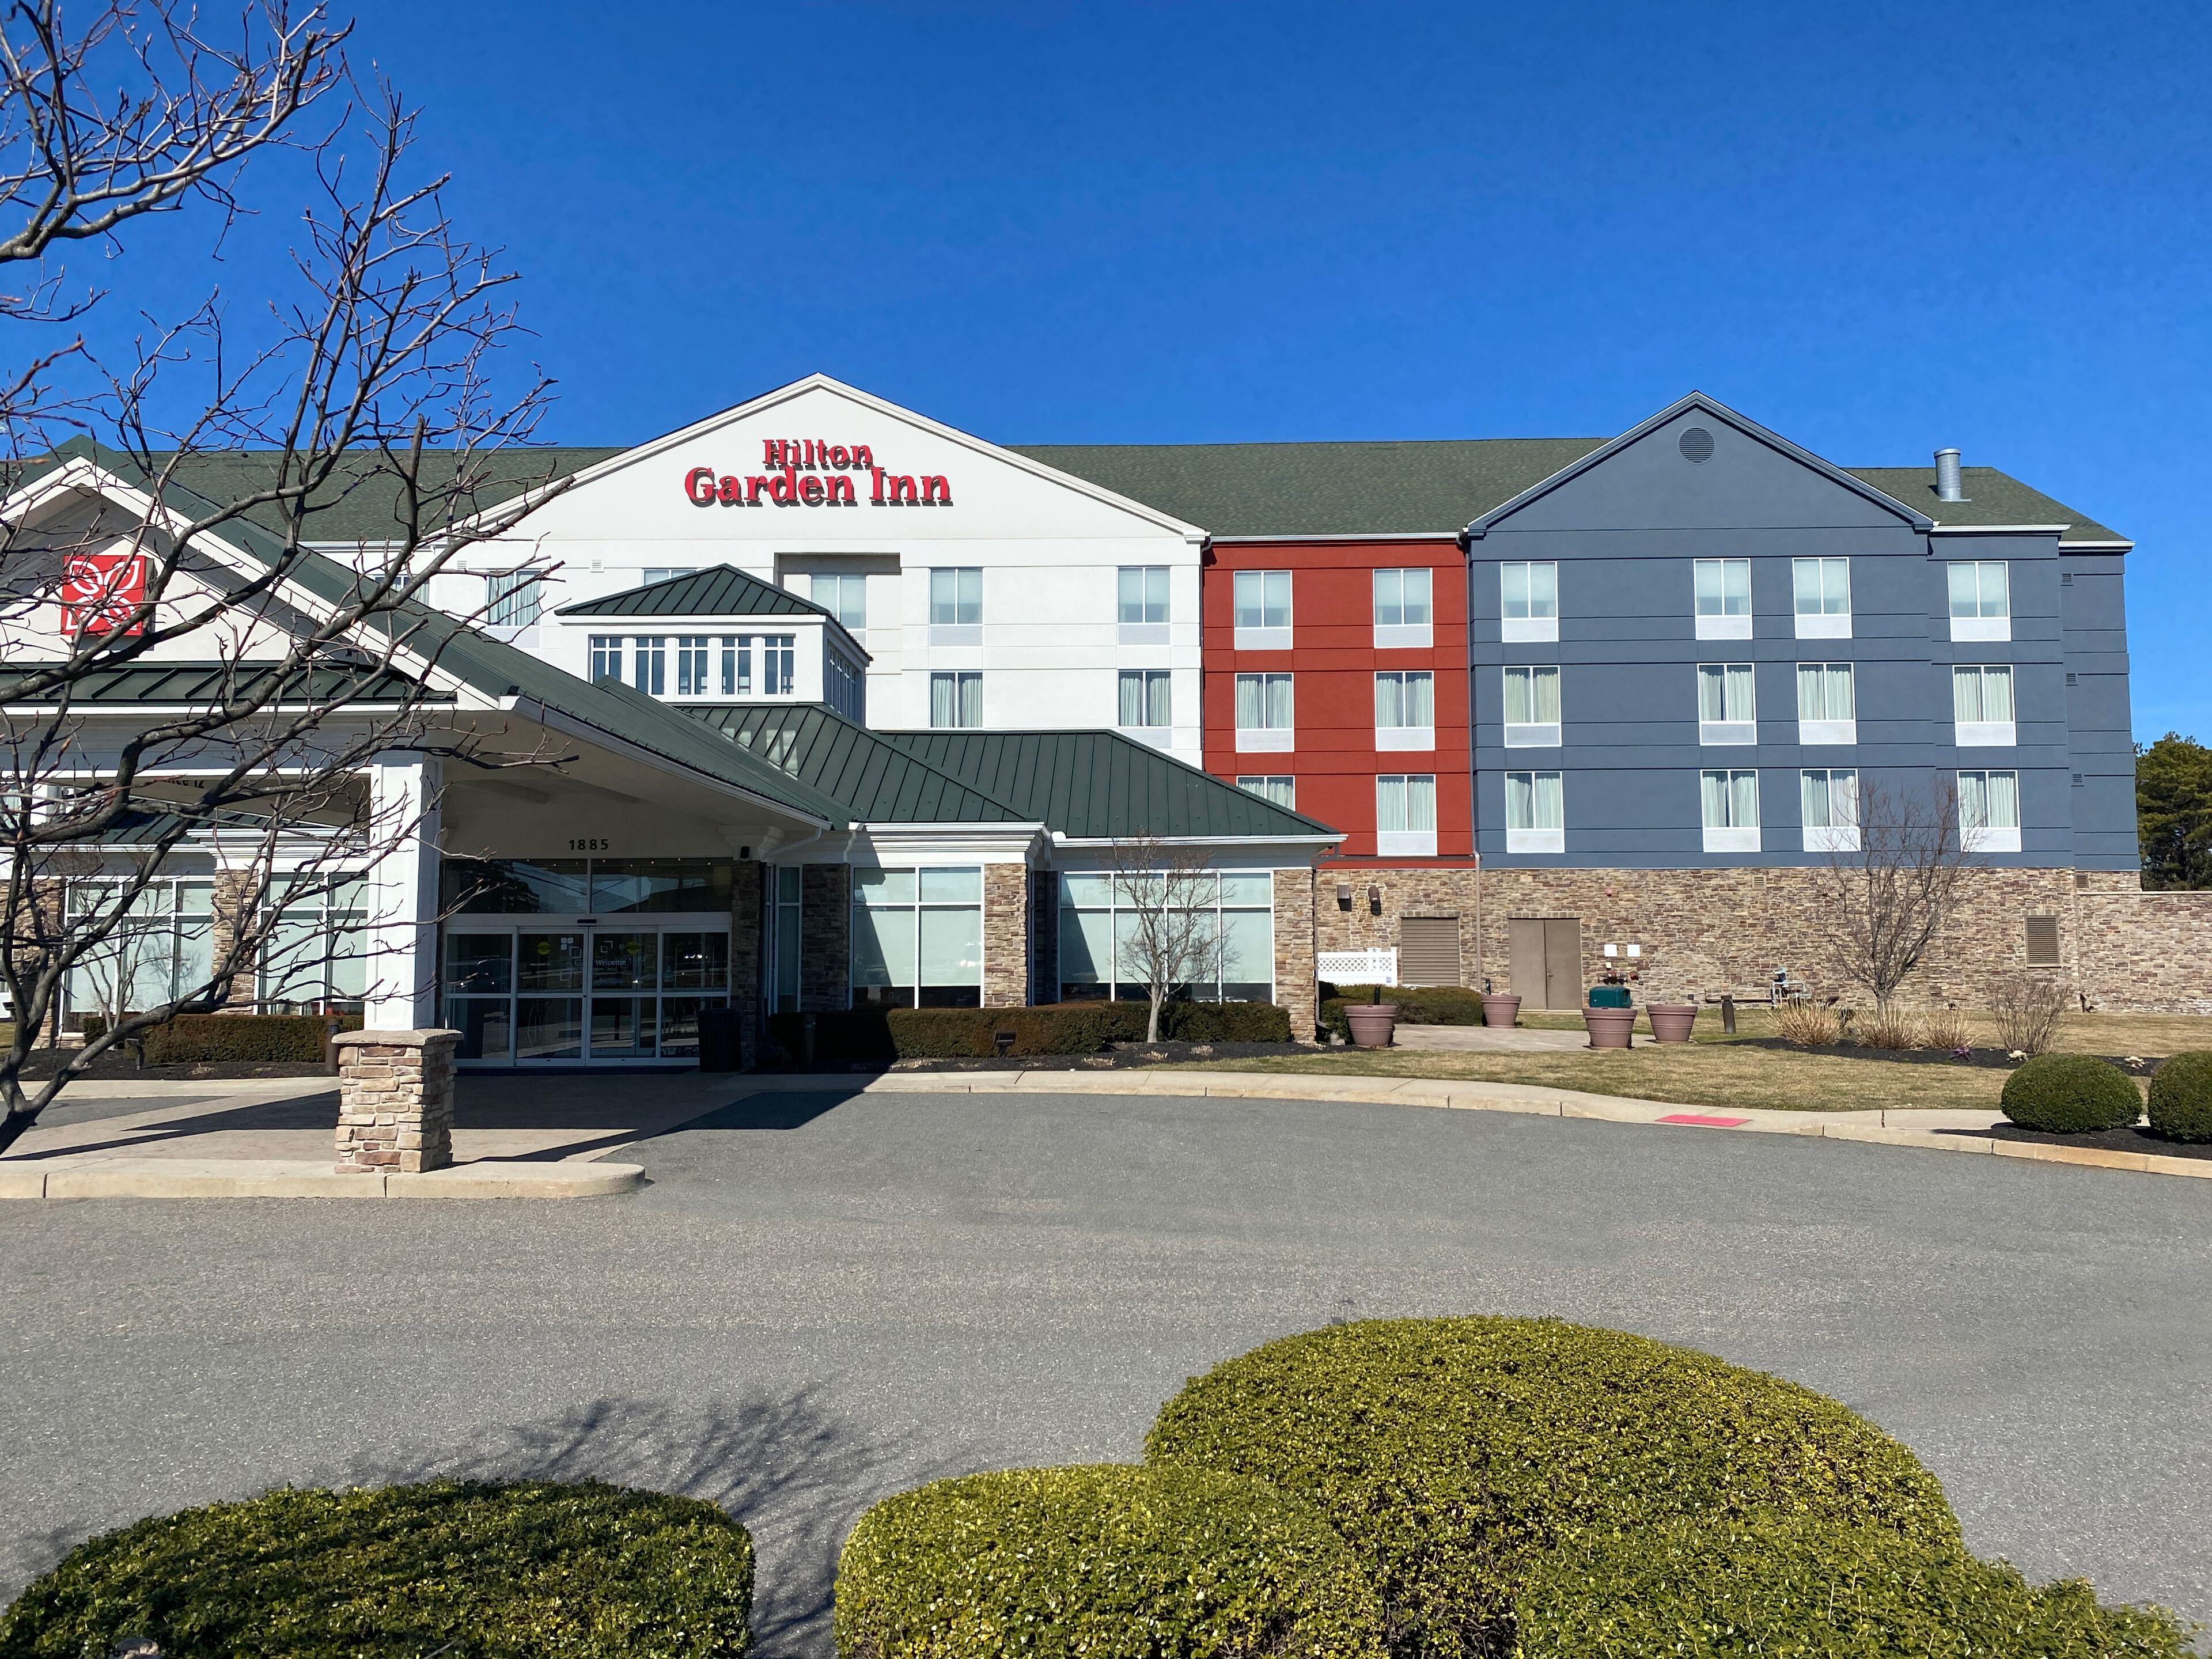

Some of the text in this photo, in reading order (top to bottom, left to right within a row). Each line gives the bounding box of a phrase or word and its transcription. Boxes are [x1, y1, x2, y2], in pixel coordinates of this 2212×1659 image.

[762, 439, 873, 465] Hilton
[684, 464, 952, 503] Garden Inn
[569, 839, 609, 850] 1885
